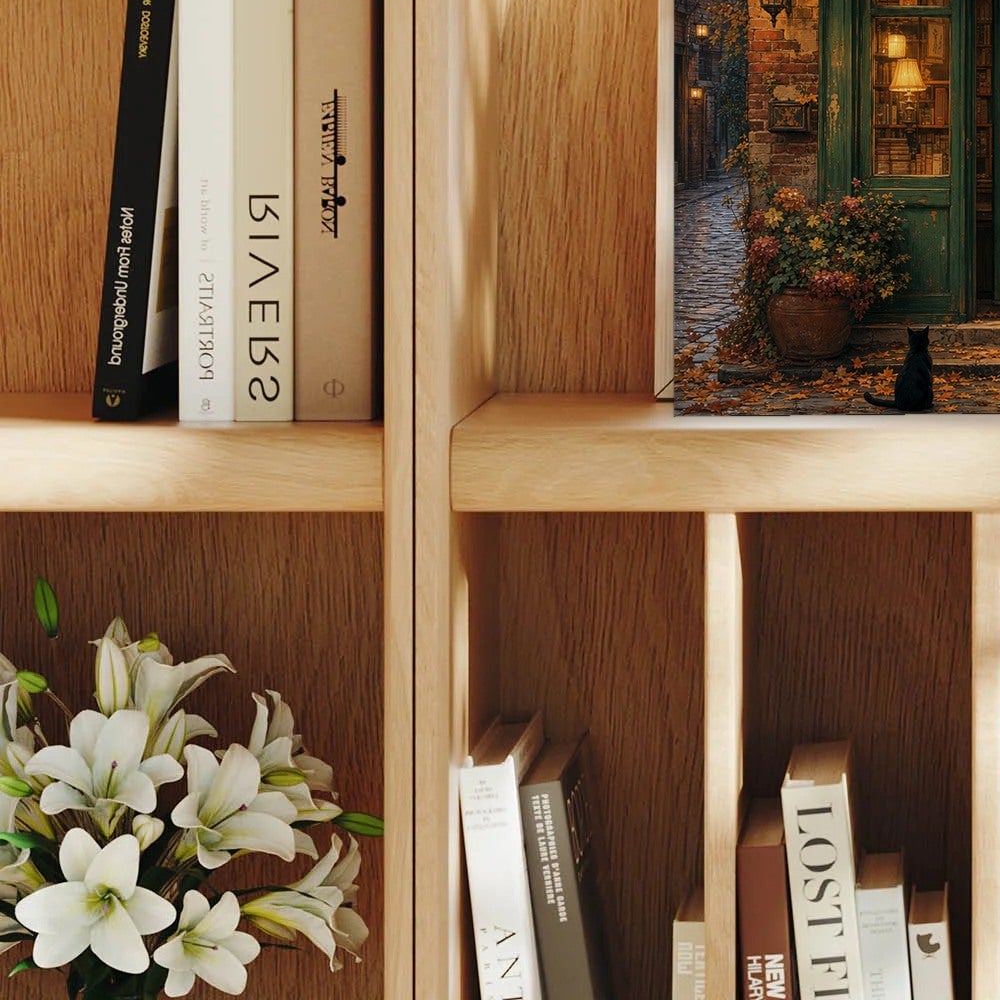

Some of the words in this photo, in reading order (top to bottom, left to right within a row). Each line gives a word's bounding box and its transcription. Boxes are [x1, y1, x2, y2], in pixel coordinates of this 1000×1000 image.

[531, 795, 543, 820] TEXTE
[535, 822, 545, 834] DE
[541, 793, 558, 860] PHOTOGRAPHIES
[537, 836, 549, 862] LAURE
[796, 802, 844, 938] LOST
[764, 953, 786, 999] NEW
